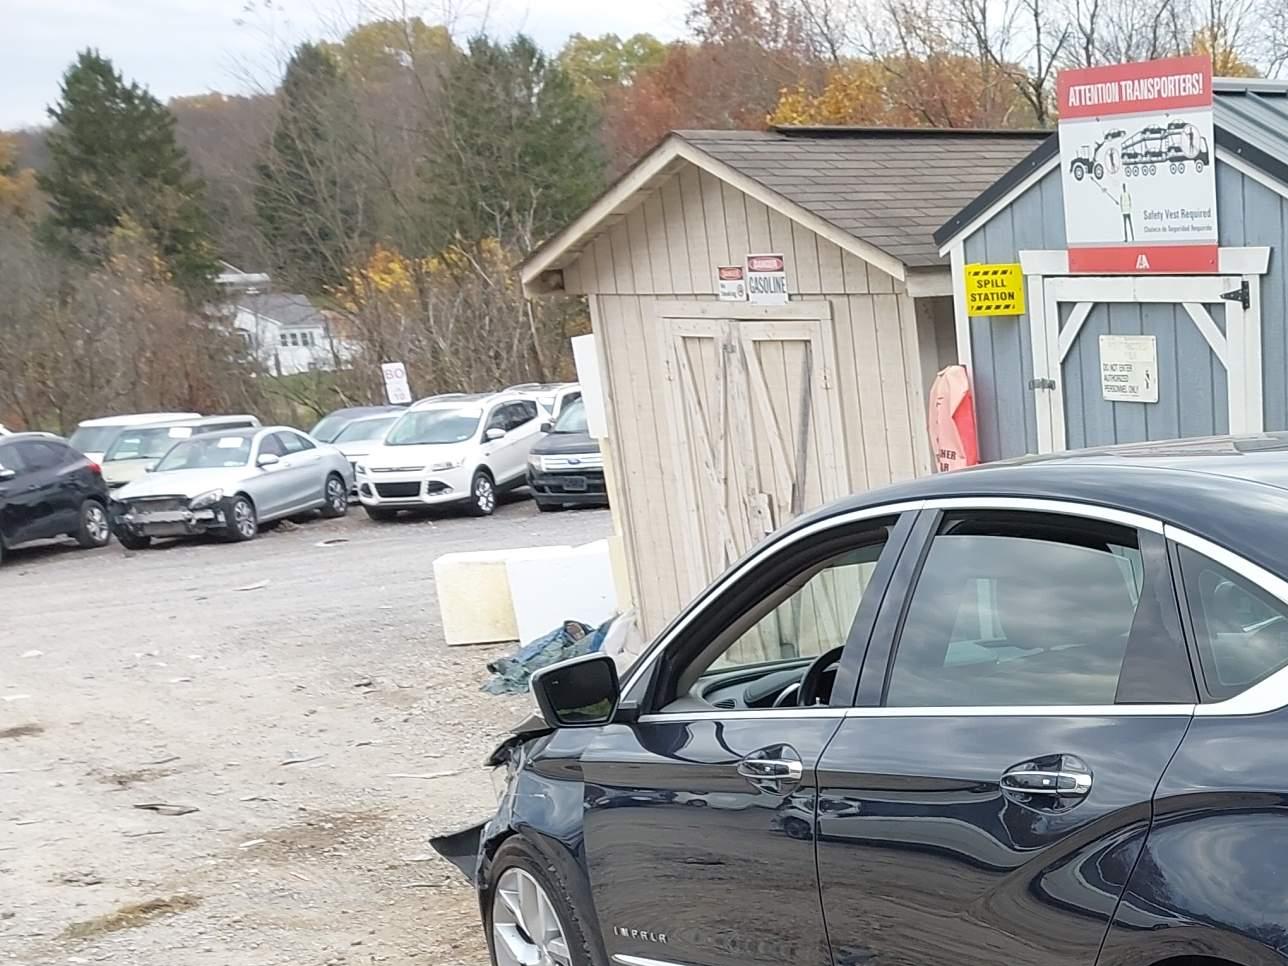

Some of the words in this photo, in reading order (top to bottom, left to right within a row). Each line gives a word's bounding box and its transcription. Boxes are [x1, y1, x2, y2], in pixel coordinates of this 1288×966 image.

[1068, 81, 1119, 107] ATTENTION
[1120, 73, 1204, 102] TRANSPORTERS!
[1143, 210, 1163, 221] Safety
[1165, 209, 1180, 220] Vest
[1181, 208, 1212, 221] Required
[749, 276, 786, 294] GASOLINE
[976, 279, 1007, 289] SPILL
[970, 291, 1015, 302] STATION
[613, 925, 667, 944] IMPALA
